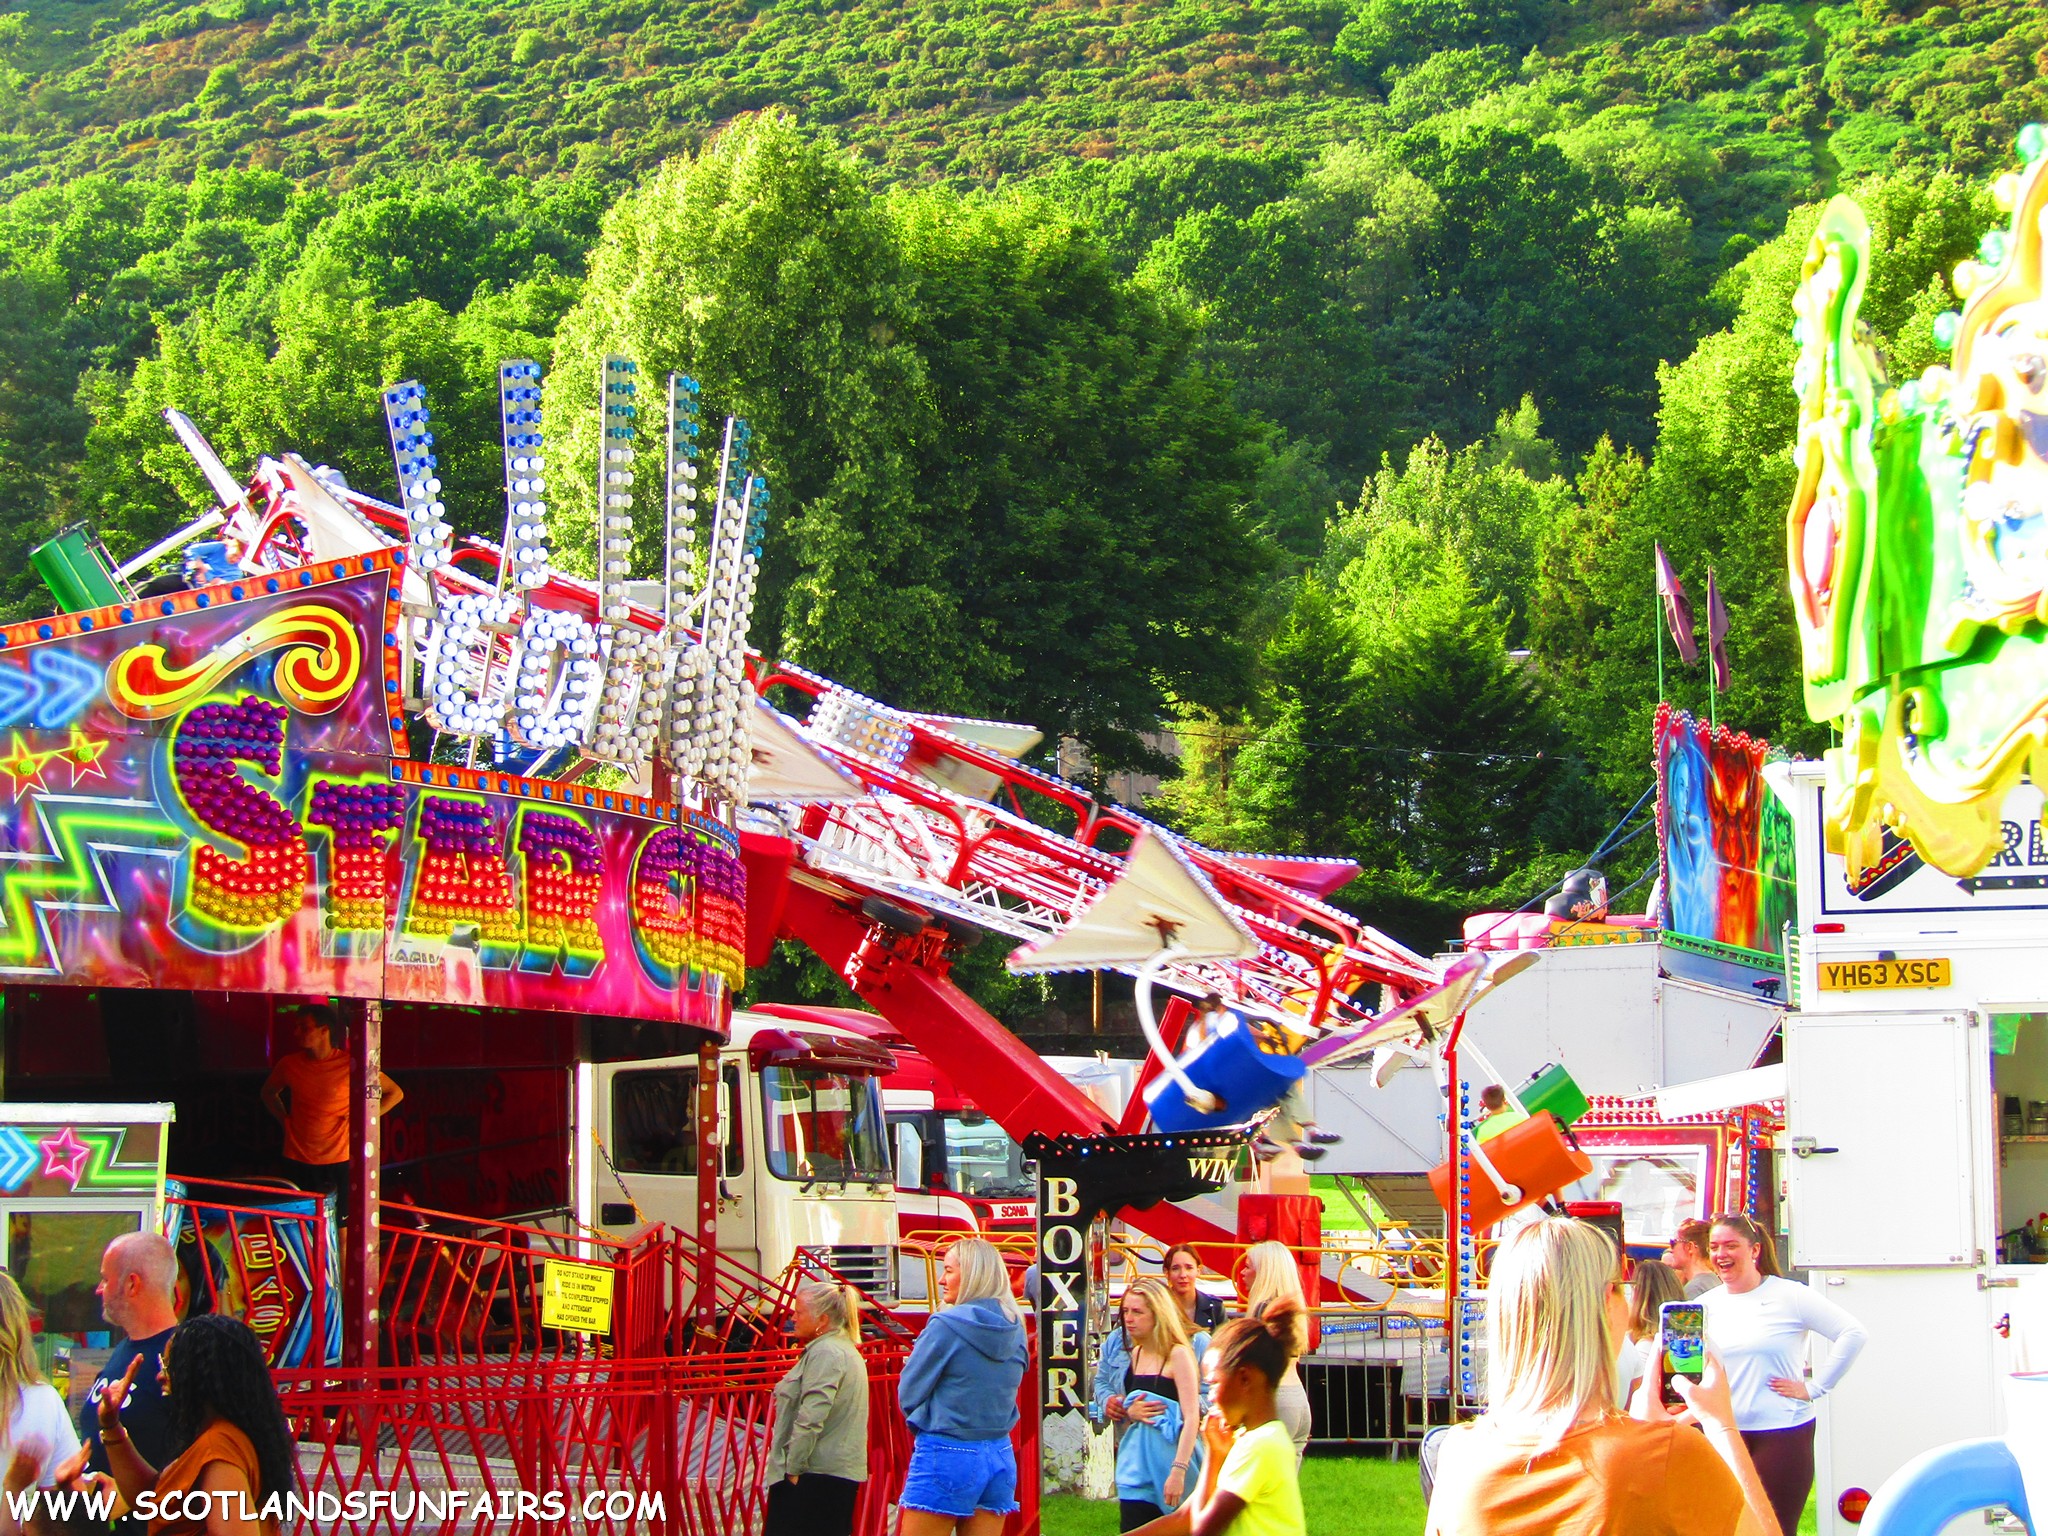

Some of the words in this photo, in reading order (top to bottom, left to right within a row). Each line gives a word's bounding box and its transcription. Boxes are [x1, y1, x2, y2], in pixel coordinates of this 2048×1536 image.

[166, 690, 606, 962] STAR
[1827, 963, 1888, 987] YH63
[1895, 961, 1941, 984] XSC
[1187, 1157, 1238, 1184] WIN
[1001, 1205, 1029, 1217] SCANIA
[563, 1270, 571, 1278] NOT
[1042, 1177, 1084, 1407] BOXER
